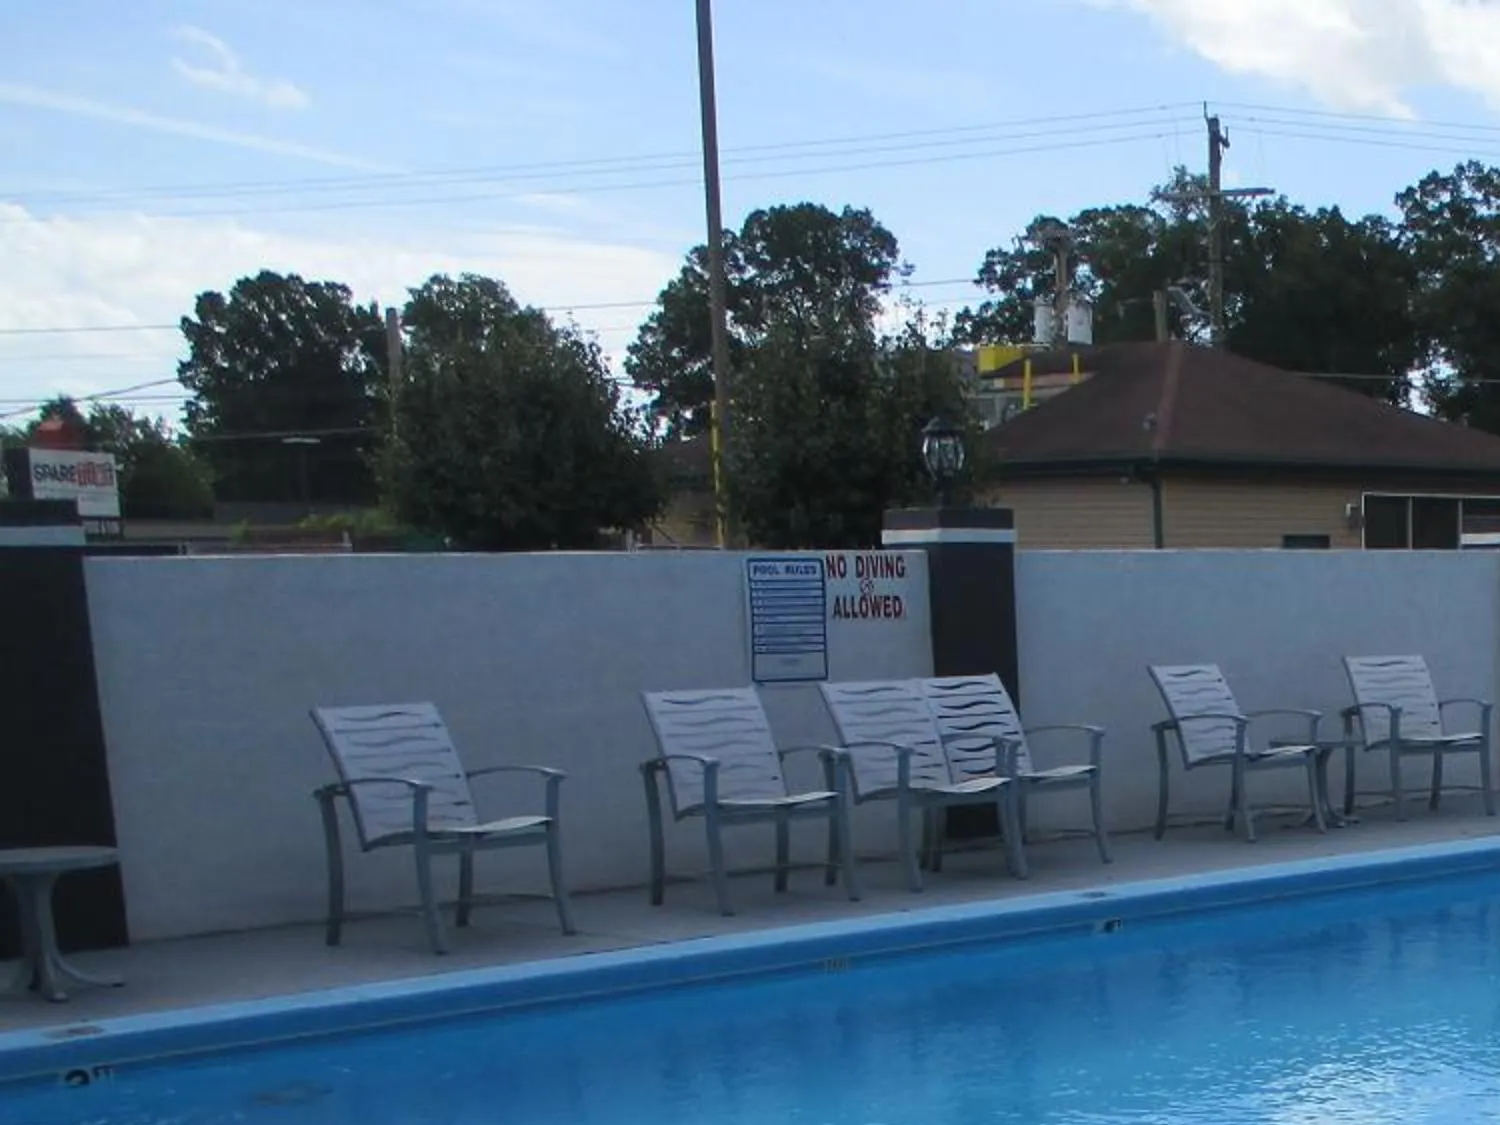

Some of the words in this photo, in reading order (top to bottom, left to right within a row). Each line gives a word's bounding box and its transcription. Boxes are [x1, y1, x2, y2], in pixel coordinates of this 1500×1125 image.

[753, 564, 779, 576] POOL
[825, 555, 847, 579] NO
[855, 555, 906, 579] DIVING
[832, 595, 904, 619] ALLOWED
